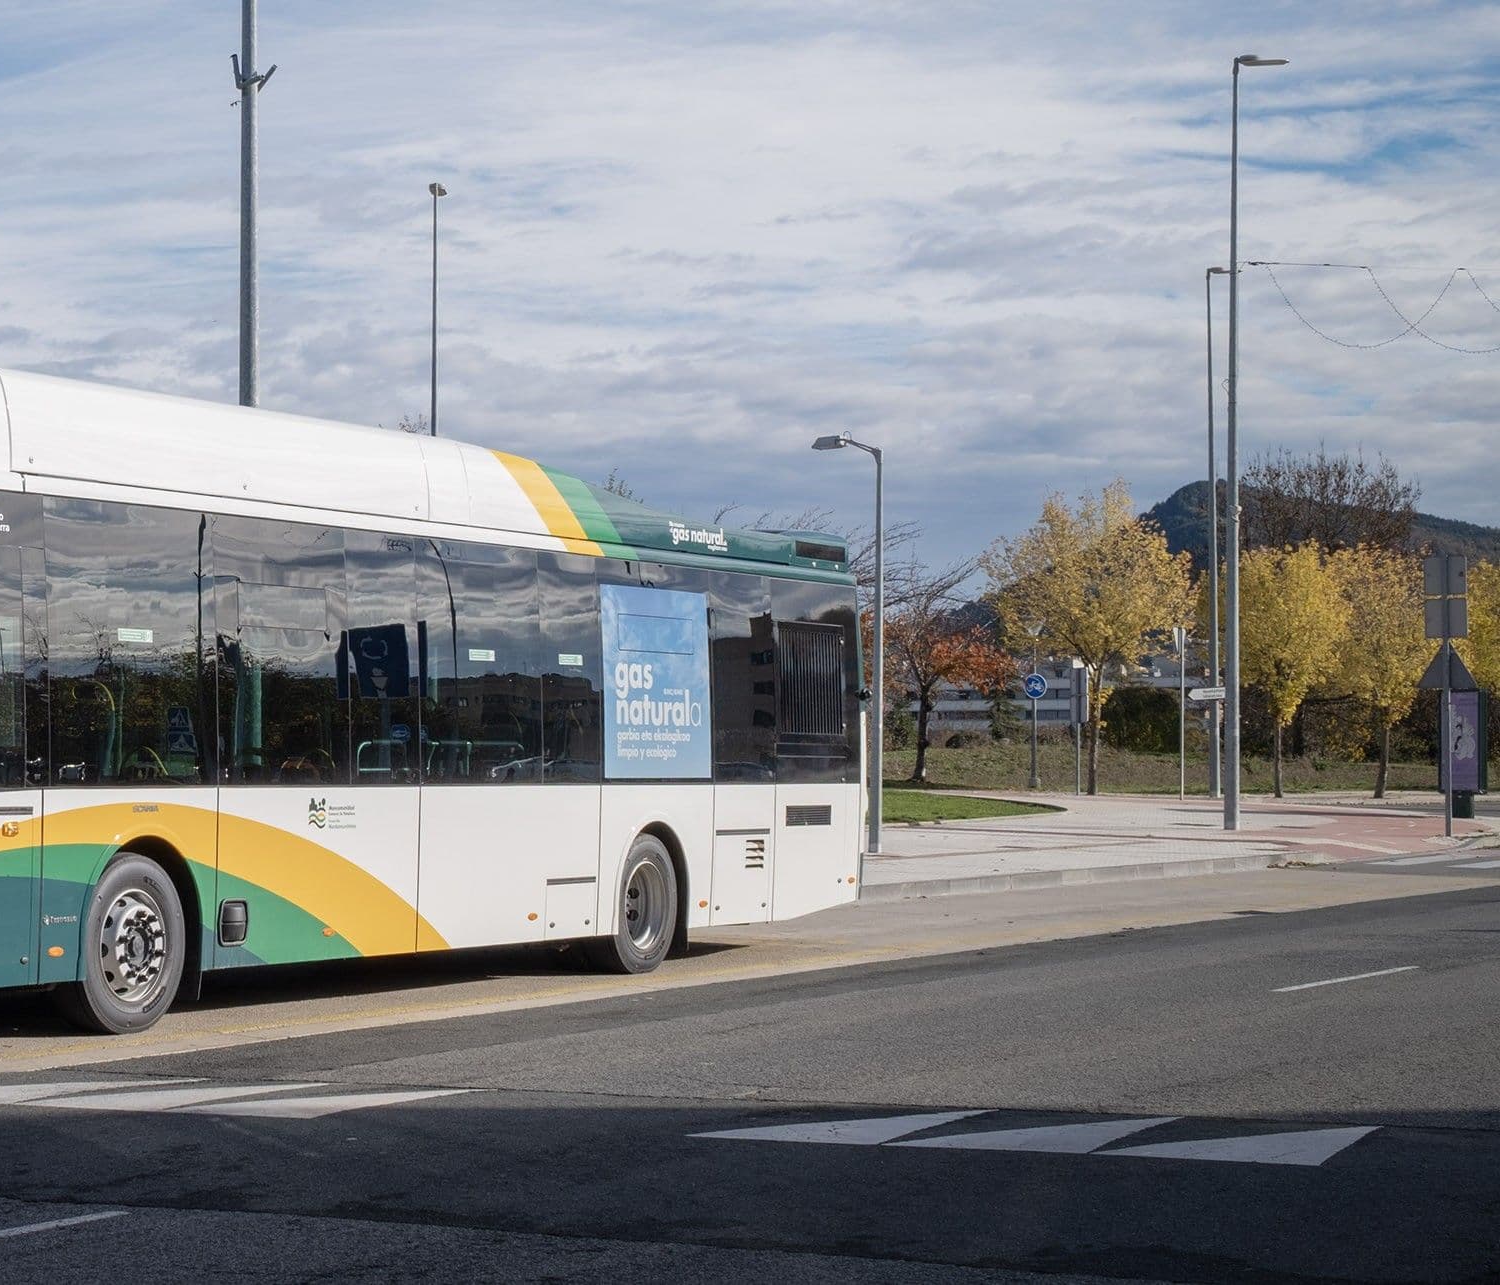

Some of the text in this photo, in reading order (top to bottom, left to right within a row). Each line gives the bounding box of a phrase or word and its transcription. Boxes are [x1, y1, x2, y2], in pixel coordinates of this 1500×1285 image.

[672, 527, 690, 545] gas
[615, 662, 653, 699] gas
[617, 744, 639, 760] limpio
